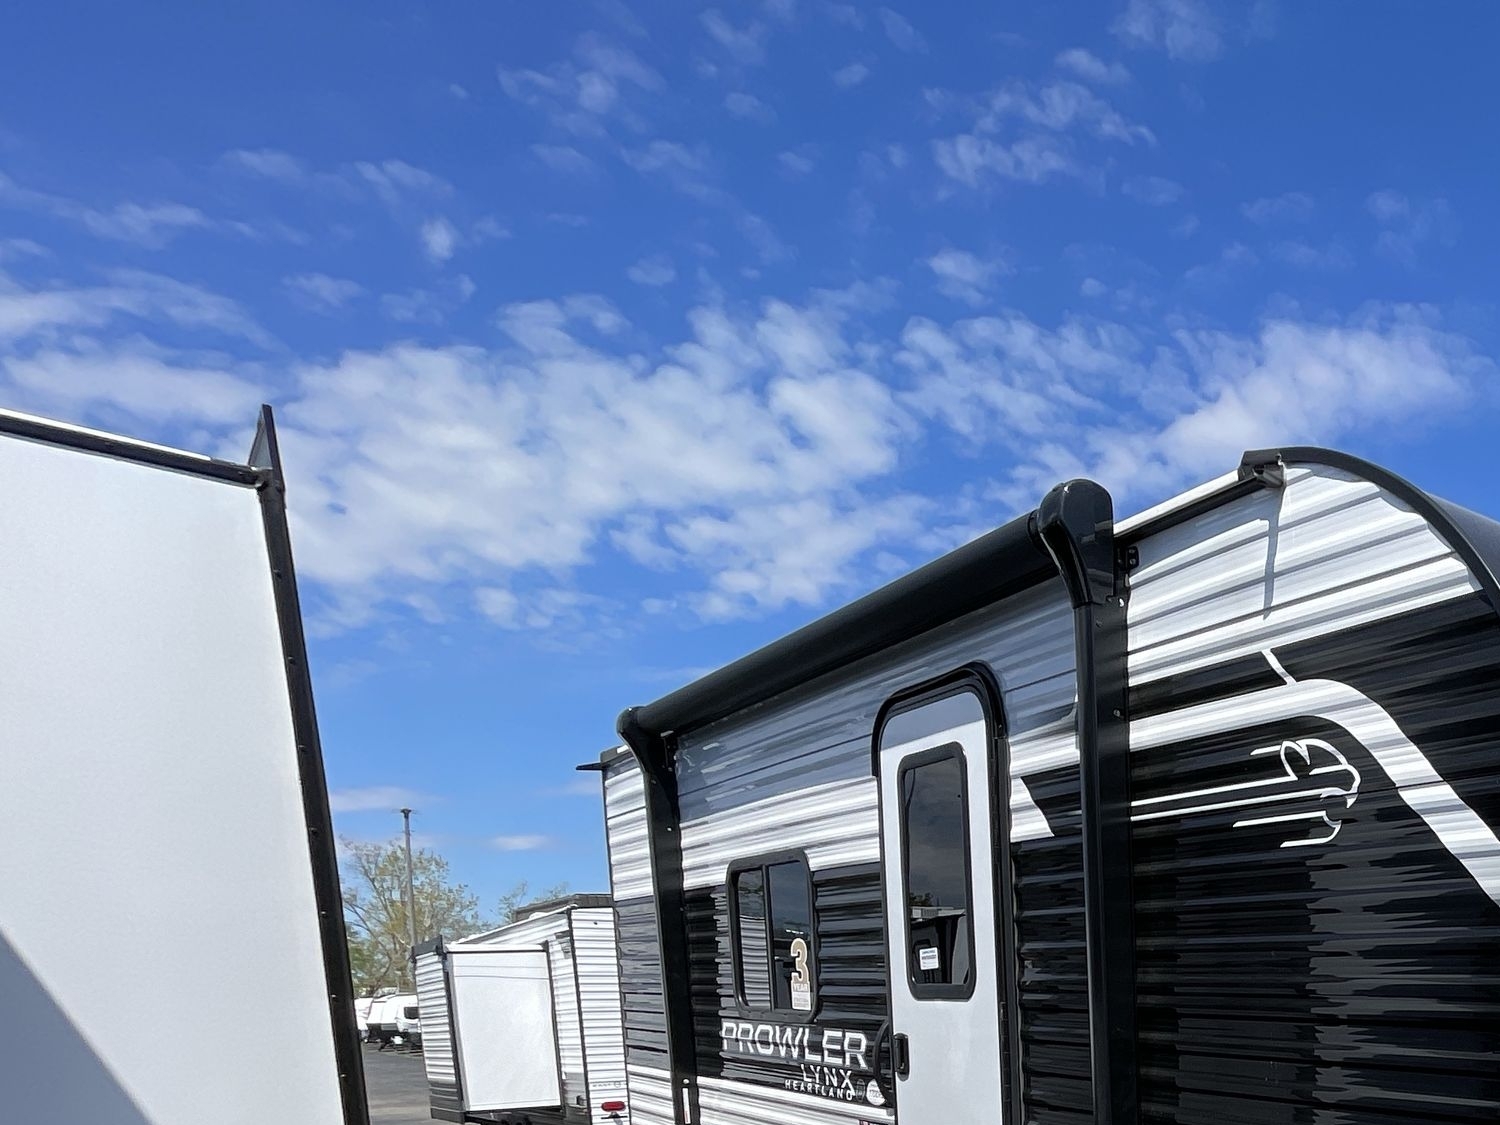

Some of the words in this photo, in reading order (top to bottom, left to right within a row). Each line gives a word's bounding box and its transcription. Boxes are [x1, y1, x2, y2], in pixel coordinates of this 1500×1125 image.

[790, 937, 809, 983] 3
[721, 1021, 869, 1070] PROWLER
[784, 1079, 853, 1101] HEARTLAND
[800, 1063, 856, 1096] LYNX
